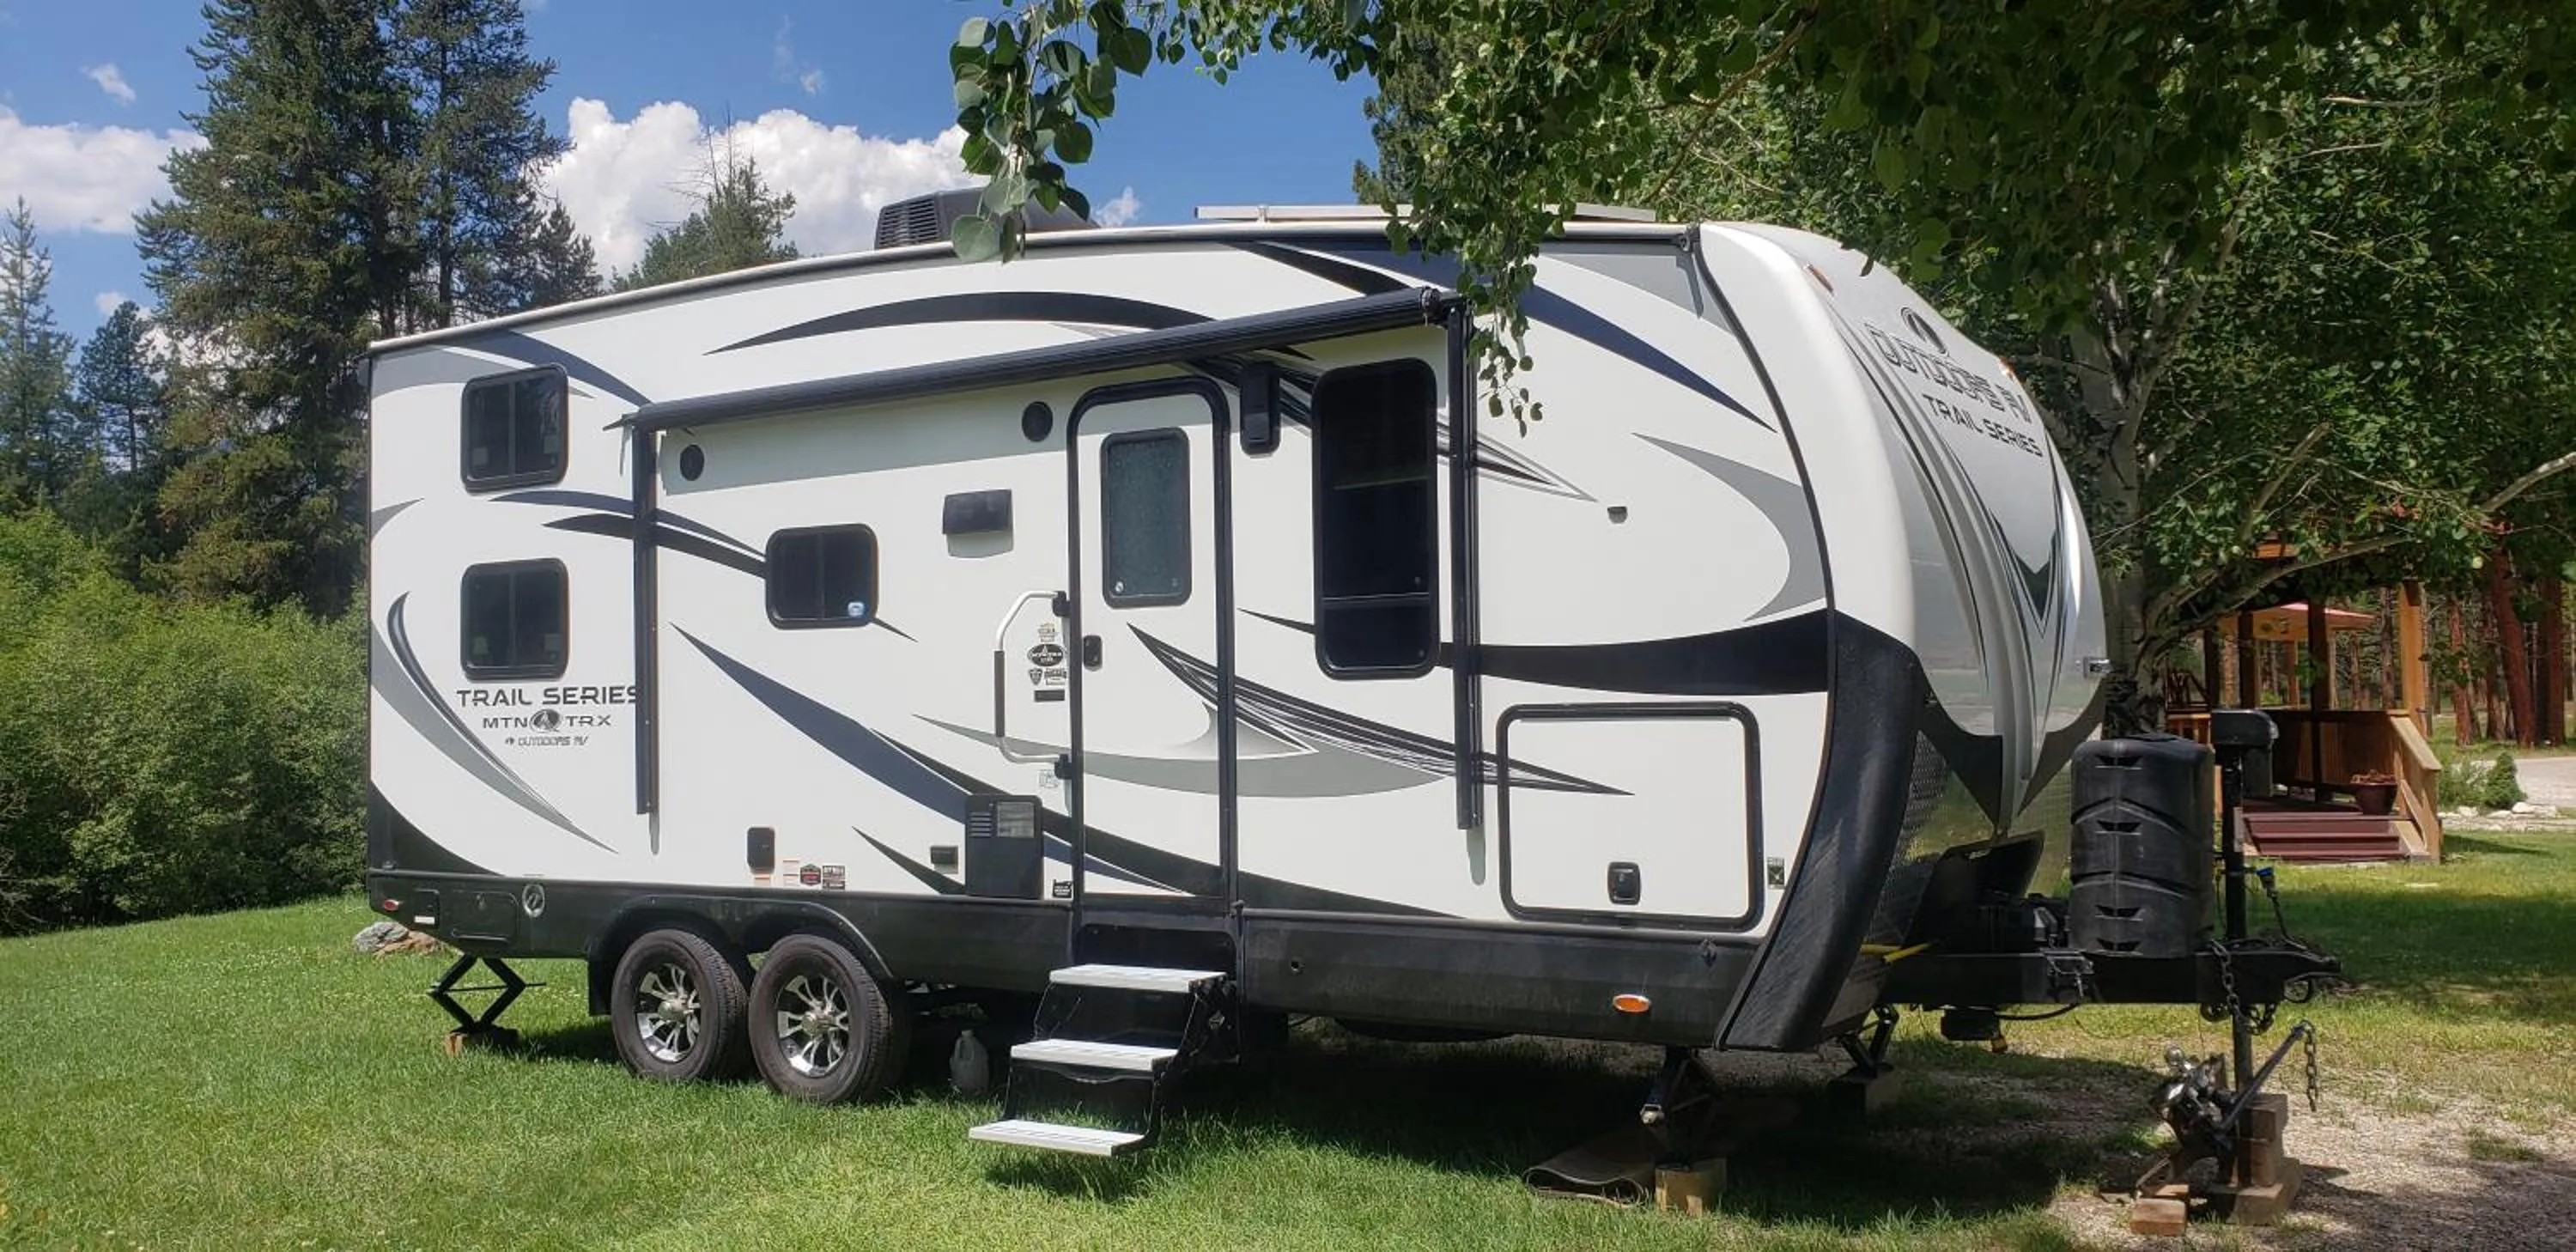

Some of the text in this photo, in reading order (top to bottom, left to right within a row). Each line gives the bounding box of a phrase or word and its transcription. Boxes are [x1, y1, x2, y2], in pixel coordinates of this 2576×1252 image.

[1922, 393, 2043, 457] TRAIL SERIES
[456, 690, 532, 707] TRAIL
[483, 714, 612, 729] MTN TRX
[518, 736, 570, 746] OUTDOORS
